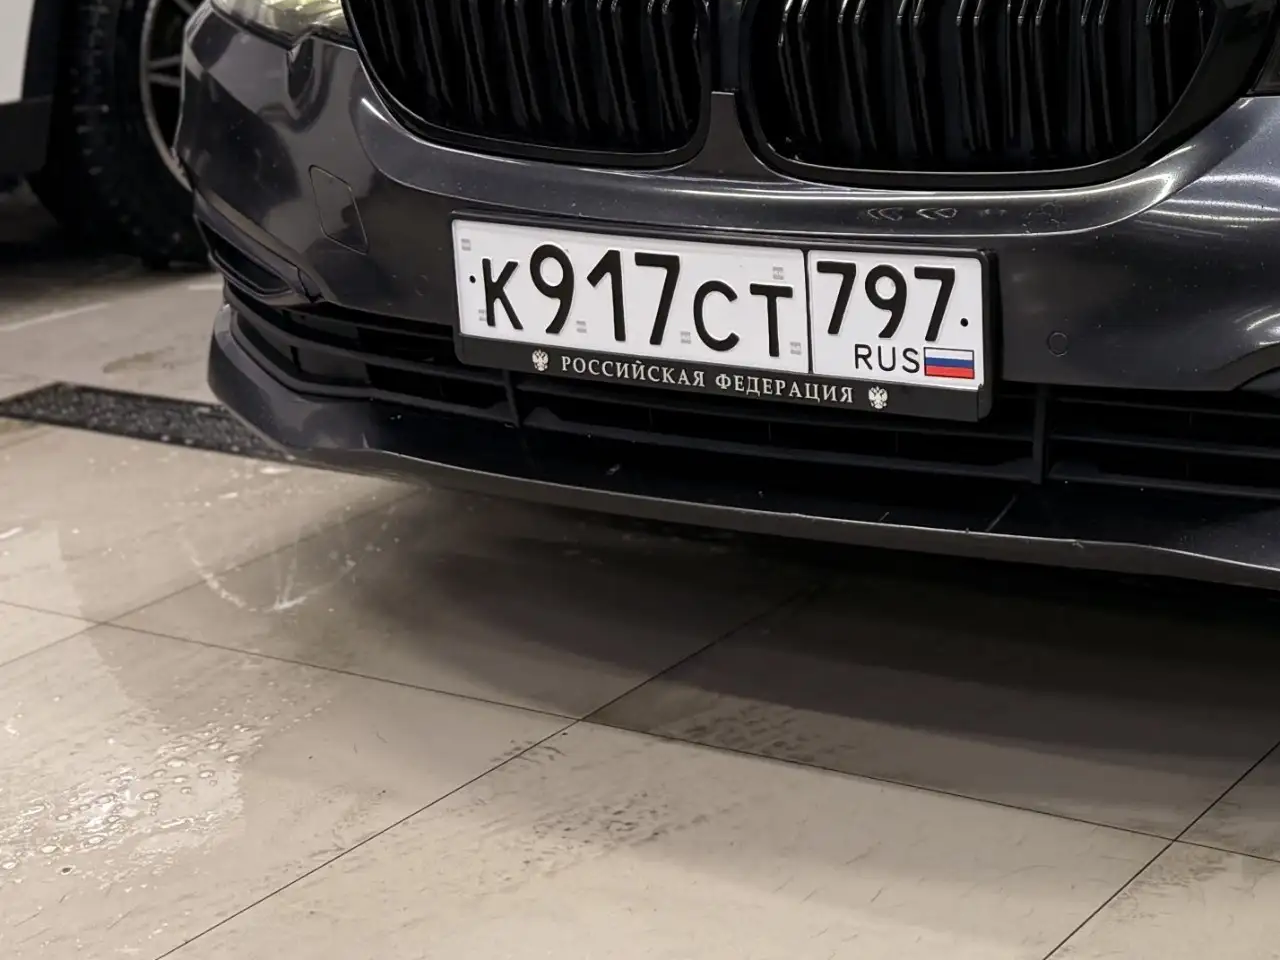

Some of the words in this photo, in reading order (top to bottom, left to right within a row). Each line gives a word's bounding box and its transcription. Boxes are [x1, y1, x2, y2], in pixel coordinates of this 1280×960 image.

[816, 260, 956, 342] 797
[561, 355, 705, 388] РОССИЙСКАЯ
[715, 373, 853, 404] ФЕДЕРАЦИЯ
[854, 343, 920, 373] RUS
